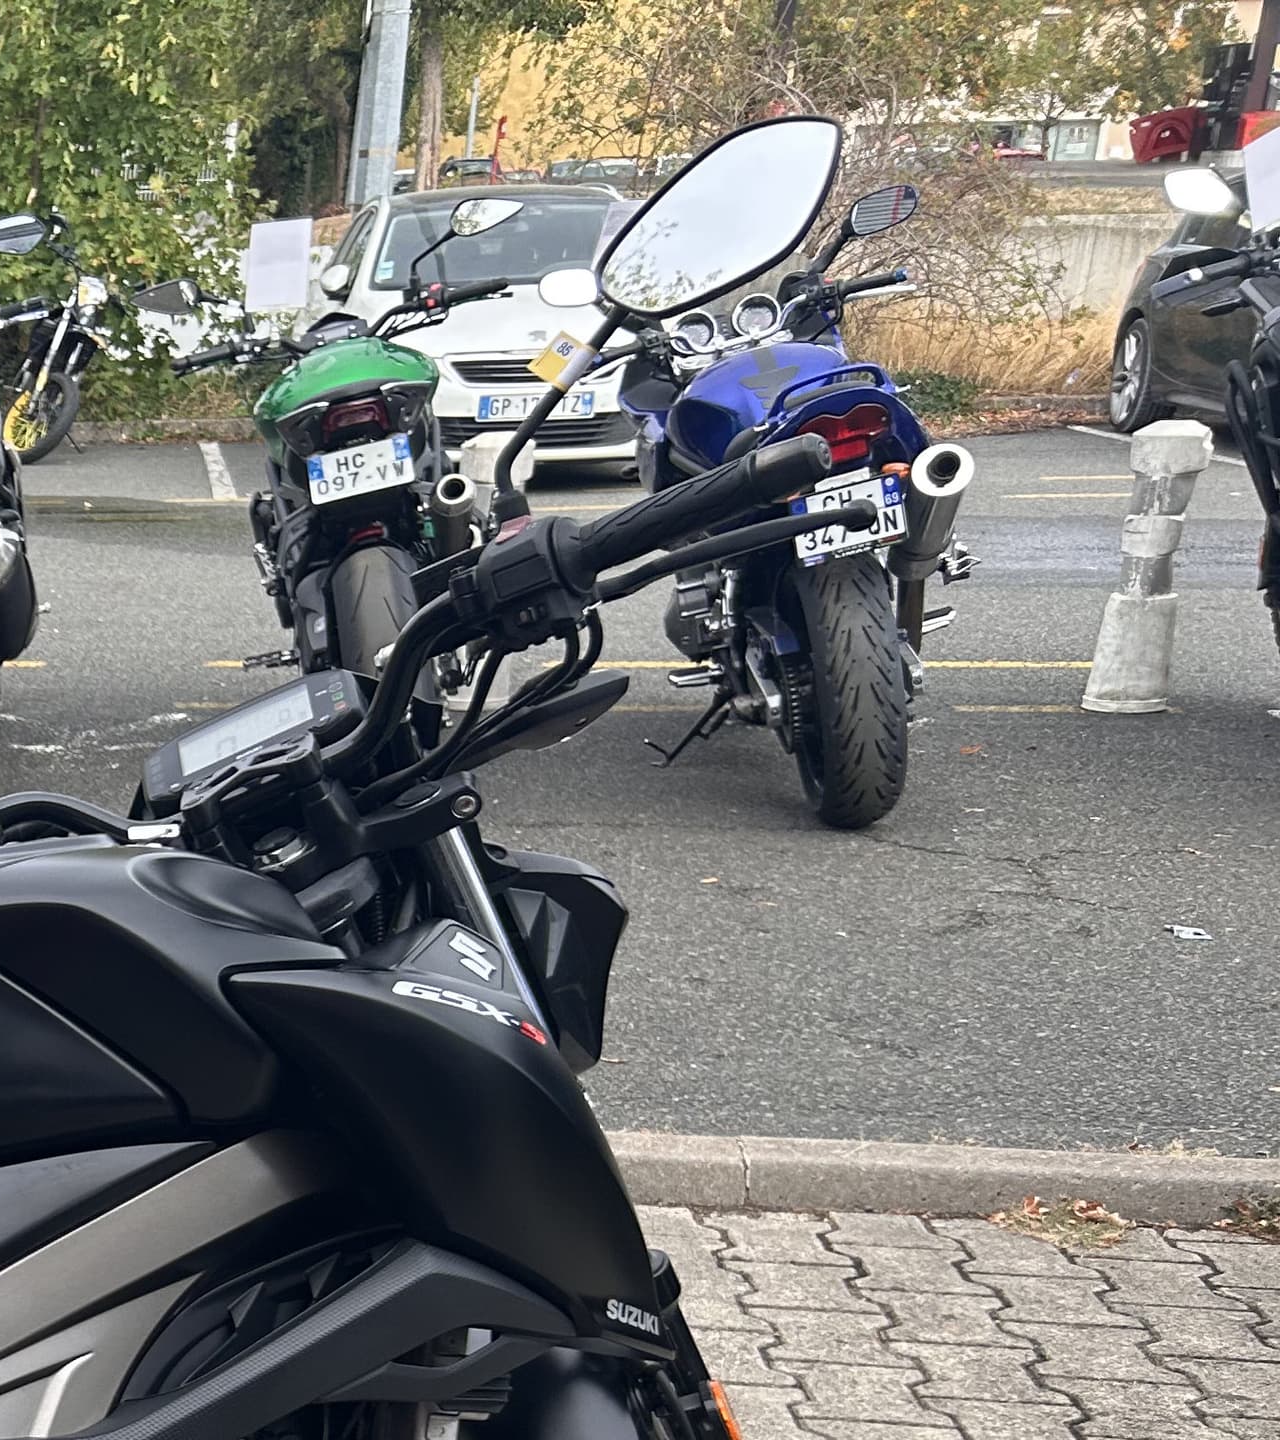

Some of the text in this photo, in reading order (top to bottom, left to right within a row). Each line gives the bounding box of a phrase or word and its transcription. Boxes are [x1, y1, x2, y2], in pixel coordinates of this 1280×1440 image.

[336, 453, 365, 473] HC
[884, 492, 899, 505] 69
[392, 980, 546, 1045] GSX-S
[606, 1298, 660, 1336] SUZUKI
